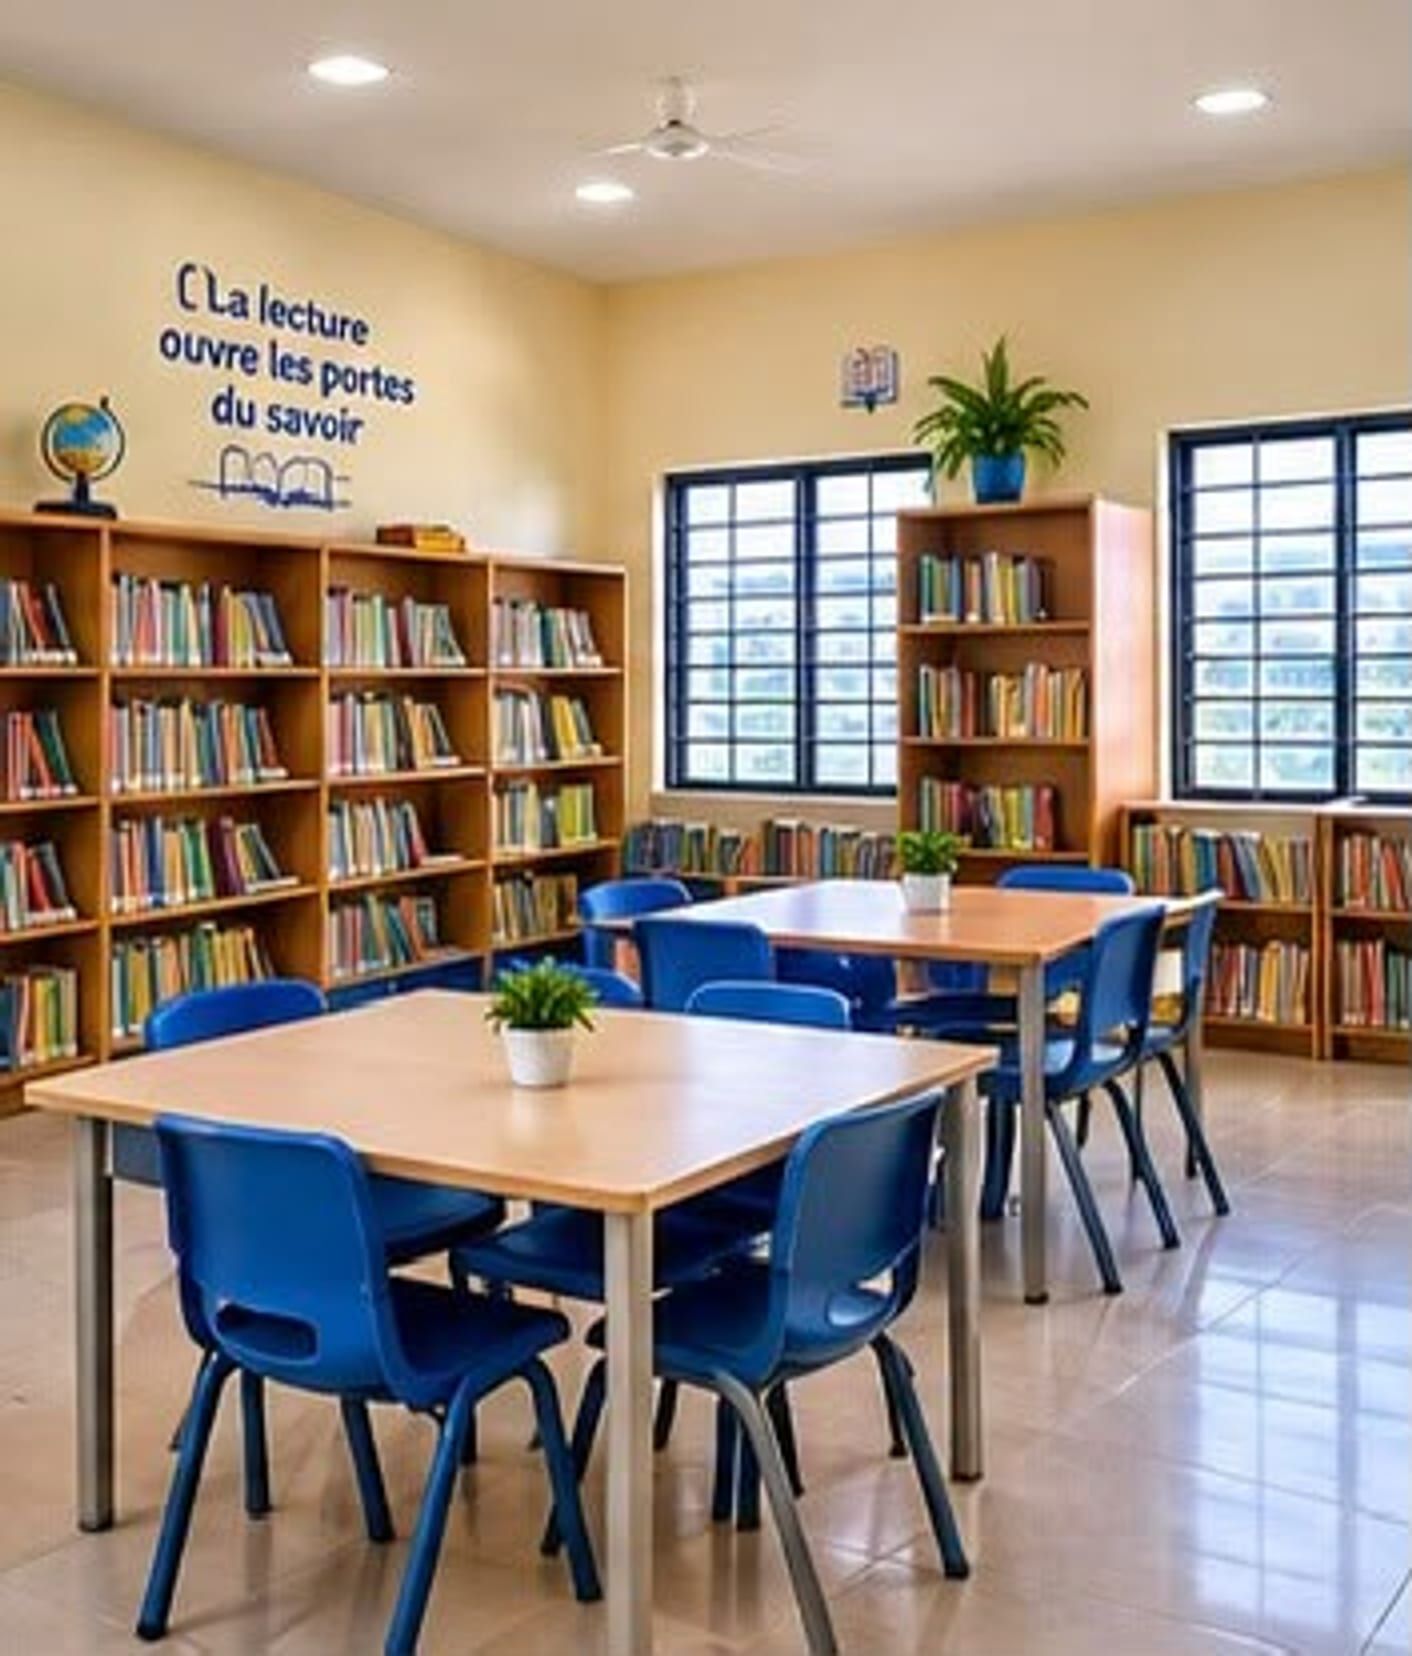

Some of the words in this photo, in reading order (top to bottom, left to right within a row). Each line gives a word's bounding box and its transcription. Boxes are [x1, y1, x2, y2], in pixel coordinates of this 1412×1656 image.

[259, 284, 369, 345] lecture
[159, 328, 257, 375] ouvre
[269, 340, 313, 385] les
[320, 360, 415, 404] portes
[211, 384, 255, 428] du
[266, 403, 365, 444] savoir
